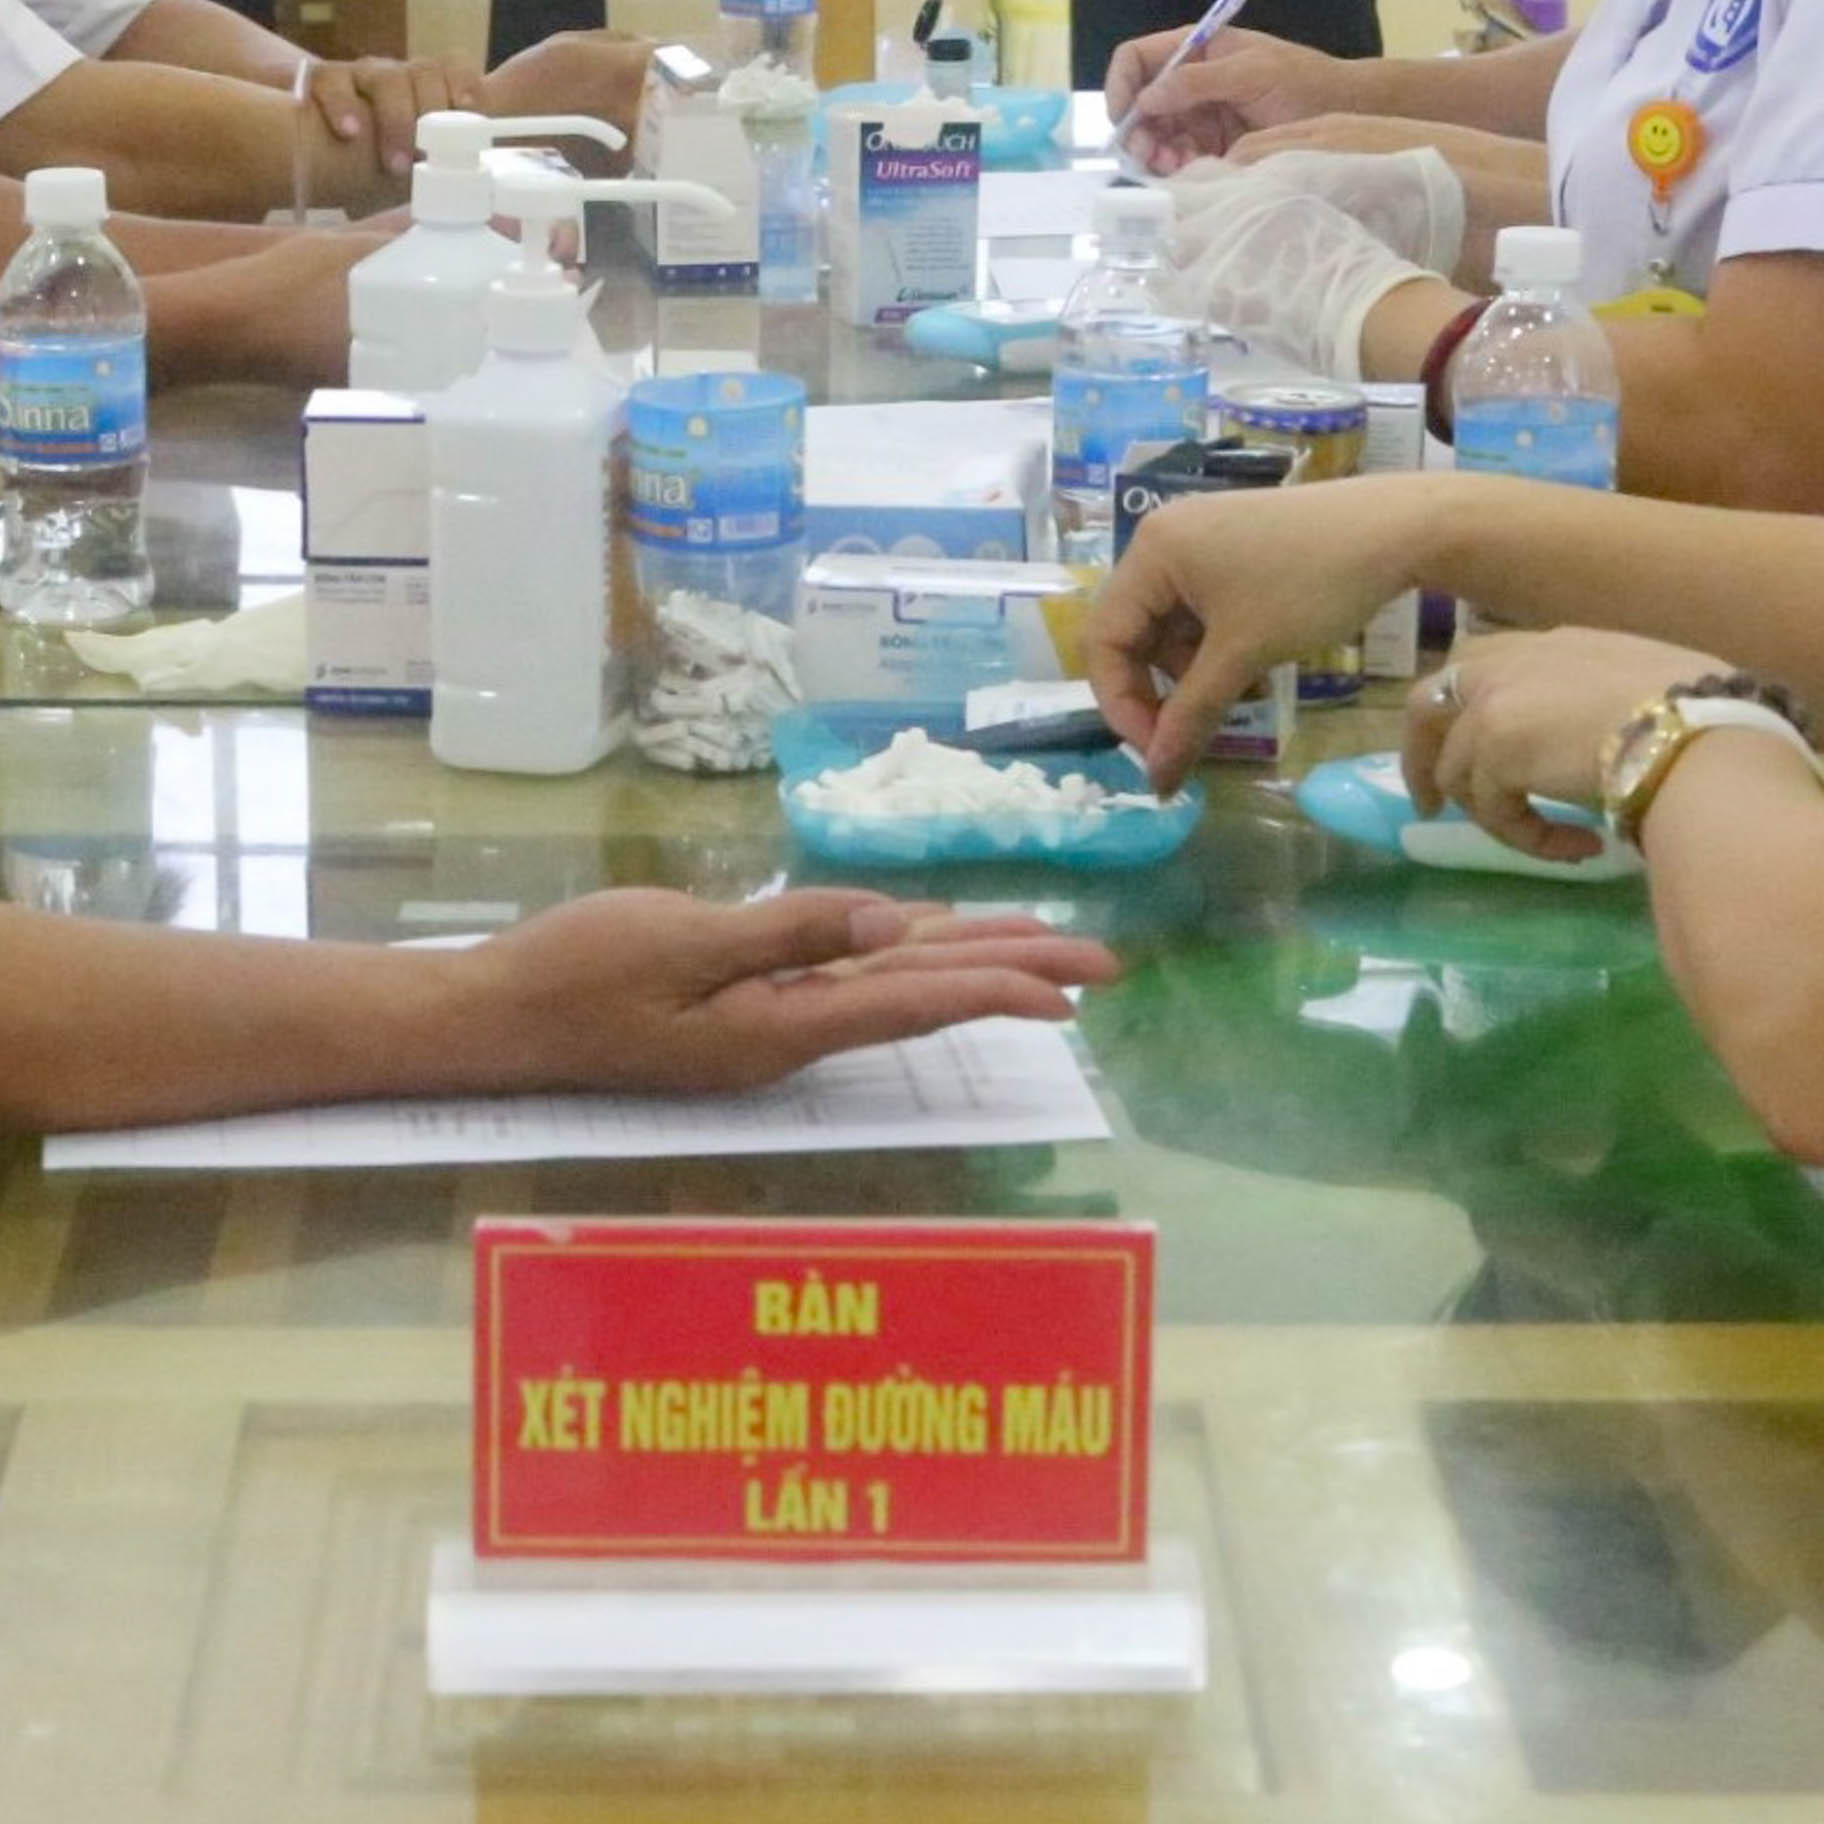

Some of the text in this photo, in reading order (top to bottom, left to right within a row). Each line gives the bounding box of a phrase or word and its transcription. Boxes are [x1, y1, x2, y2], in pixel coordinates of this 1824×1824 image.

[876, 159, 972, 179] UltraSoft
[755, 1268, 879, 1336] BÀN
[519, 1363, 1113, 1466] XÉT NGHIỆM ĐƯỜNG MÁU
[867, 1480, 889, 1535] 1
